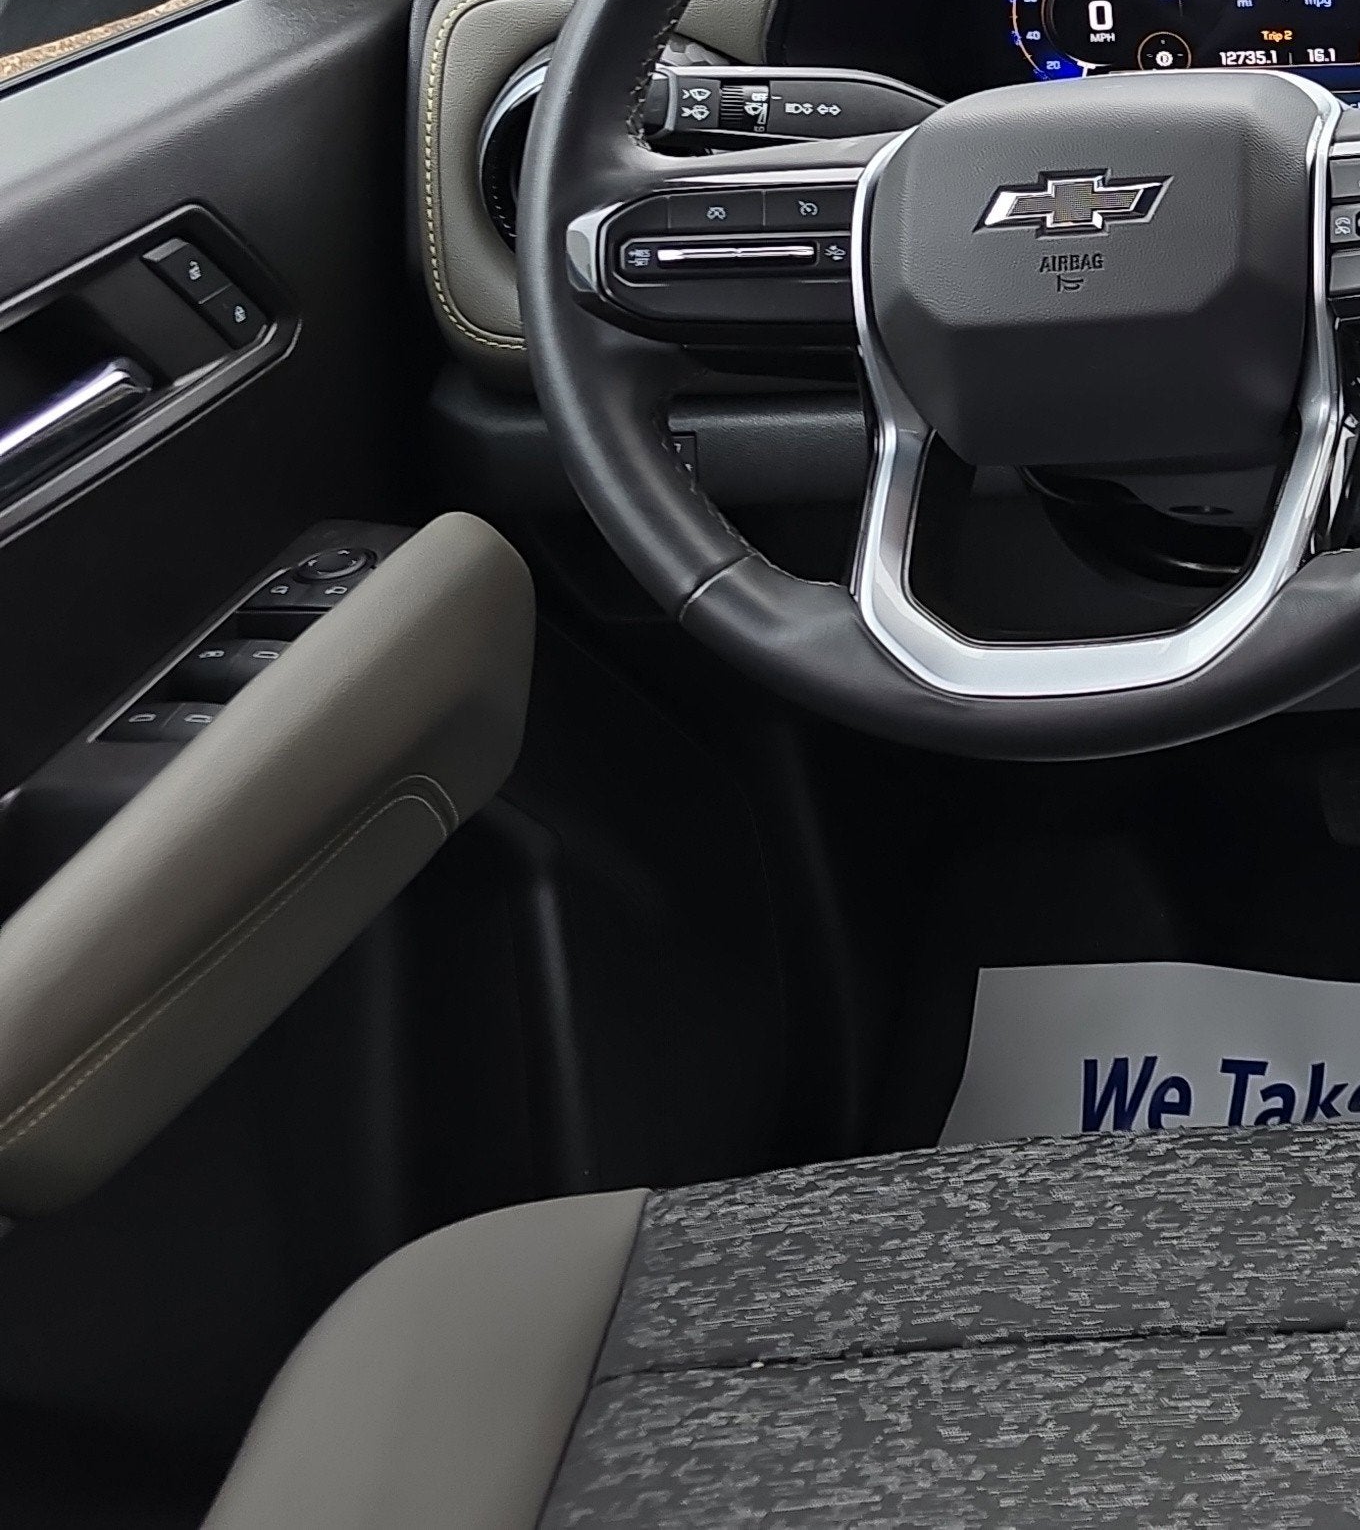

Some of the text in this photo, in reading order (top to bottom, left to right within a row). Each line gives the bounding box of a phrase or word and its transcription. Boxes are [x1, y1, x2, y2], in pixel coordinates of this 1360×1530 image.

[1088, 0, 1113, 31] 0
[1026, 31, 1041, 40] 40
[1090, 33, 1115, 43] MPH
[1261, 30, 1293, 42] Trip 2
[1219, 50, 1278, 65] 12735.1
[1307, 48, 1336, 63] 16.1
[1046, 61, 1060, 70] 20
[1039, 253, 1104, 273] AIRBAG
[1080, 1055, 1193, 1133] We
